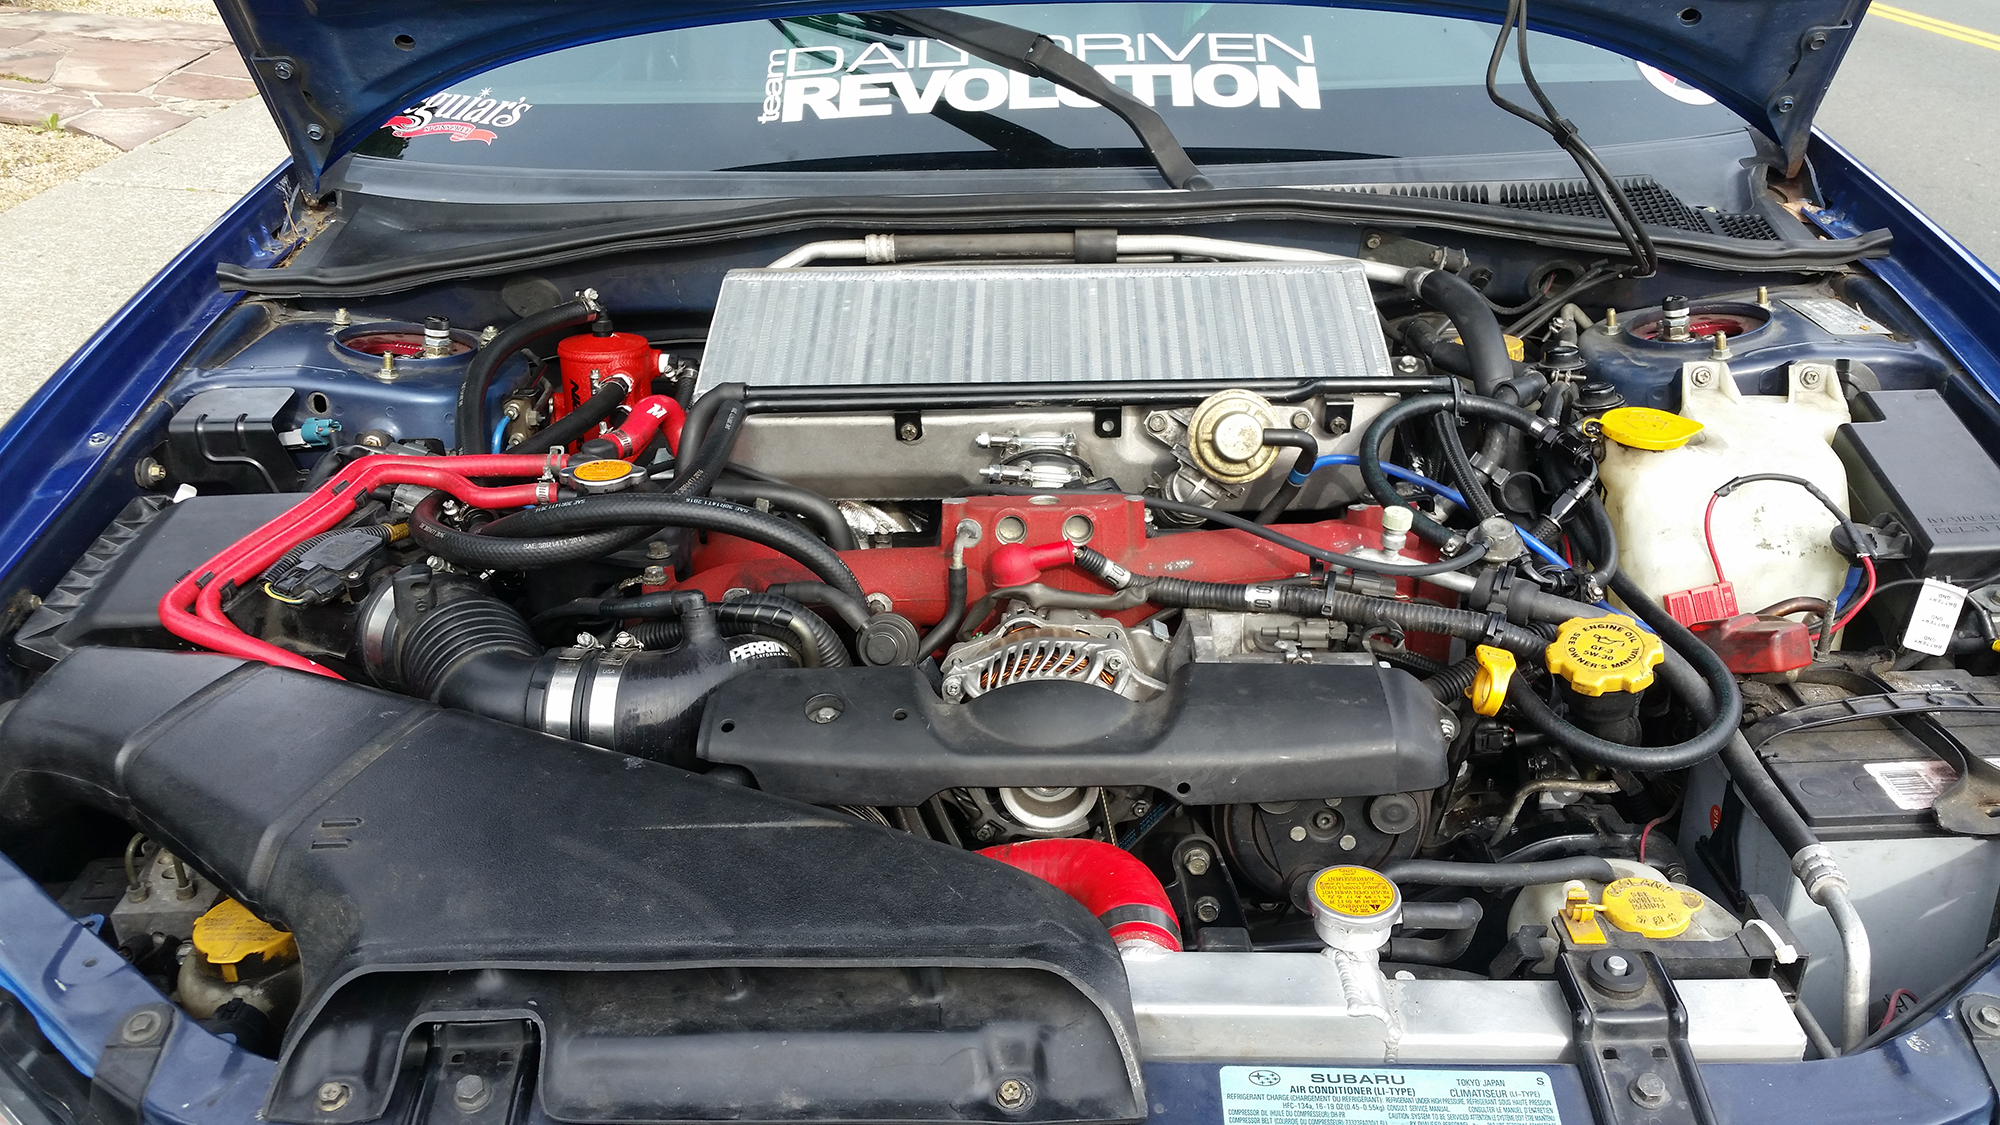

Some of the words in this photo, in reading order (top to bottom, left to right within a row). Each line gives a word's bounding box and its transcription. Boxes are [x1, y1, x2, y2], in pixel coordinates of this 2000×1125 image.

[757, 49, 787, 124] team
[1568, 632, 1581, 645] SEE
[1582, 623, 1624, 633] ENGINE
[1624, 631, 1637, 643] OIL
[729, 640, 788, 663] PERRIN
[1590, 645, 1614, 654] GF-3
[1568, 647, 1608, 669] OWNER'S
[1583, 650, 1614, 661] 5W-30
[1611, 647, 1640, 669] MANUAL
[1606, 879, 1674, 897] COOLANT
[1310, 1073, 1406, 1085] SUBARU
[1456, 1078, 1481, 1087] TOKYO
[1482, 1079, 1506, 1087] JAPAN
[1536, 1077, 1545, 1086] S
[1289, 1085, 1307, 1094] AIR
[1308, 1086, 1372, 1095] CONDITIONER
[1374, 1087, 1416, 1096] (LI-TYPE)
[1449, 1089, 1508, 1098] CLIMATISEUR
[1282, 1102, 1314, 1110] HFC-134a,
[1446, 1113, 1469, 1121] SERVICED
